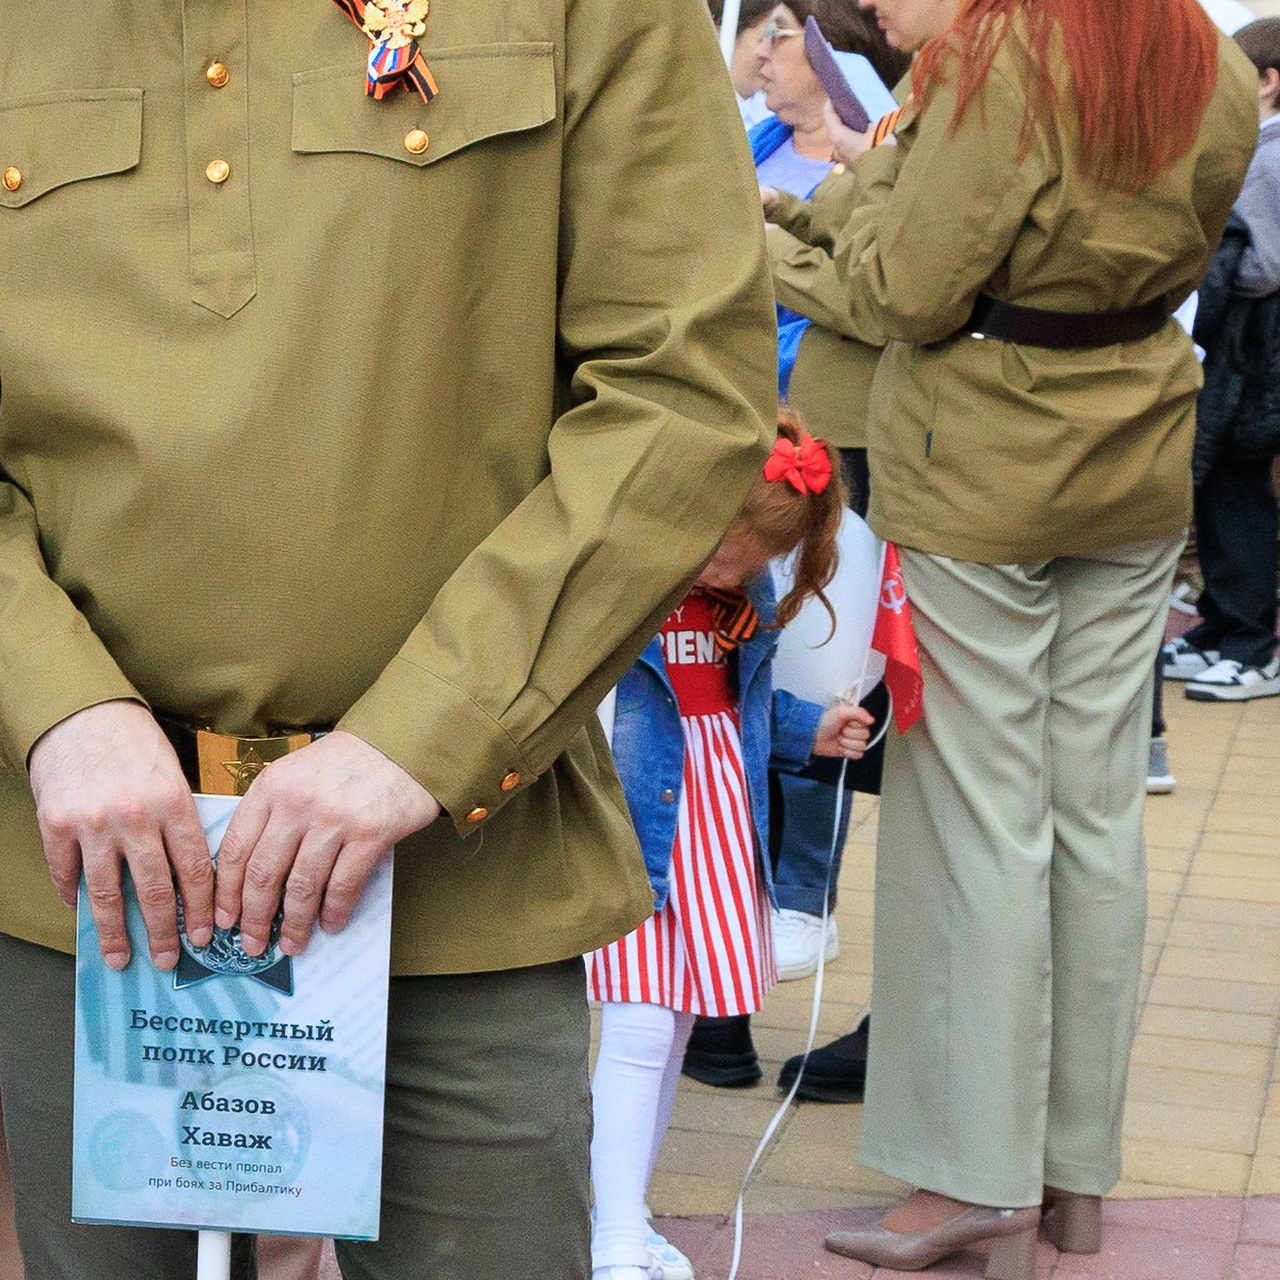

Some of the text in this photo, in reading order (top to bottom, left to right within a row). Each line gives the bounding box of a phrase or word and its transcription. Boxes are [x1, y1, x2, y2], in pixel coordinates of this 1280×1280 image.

[130, 1009, 335, 1041] Бессмертный
[142, 1045, 327, 1072] полк России
[180, 1091, 276, 1114] Абазов
[181, 1126, 272, 1149] Хаваж
[170, 1157, 282, 1173] Без вести пропал
[148, 1177, 303, 1198] при боях за Прибалтику
